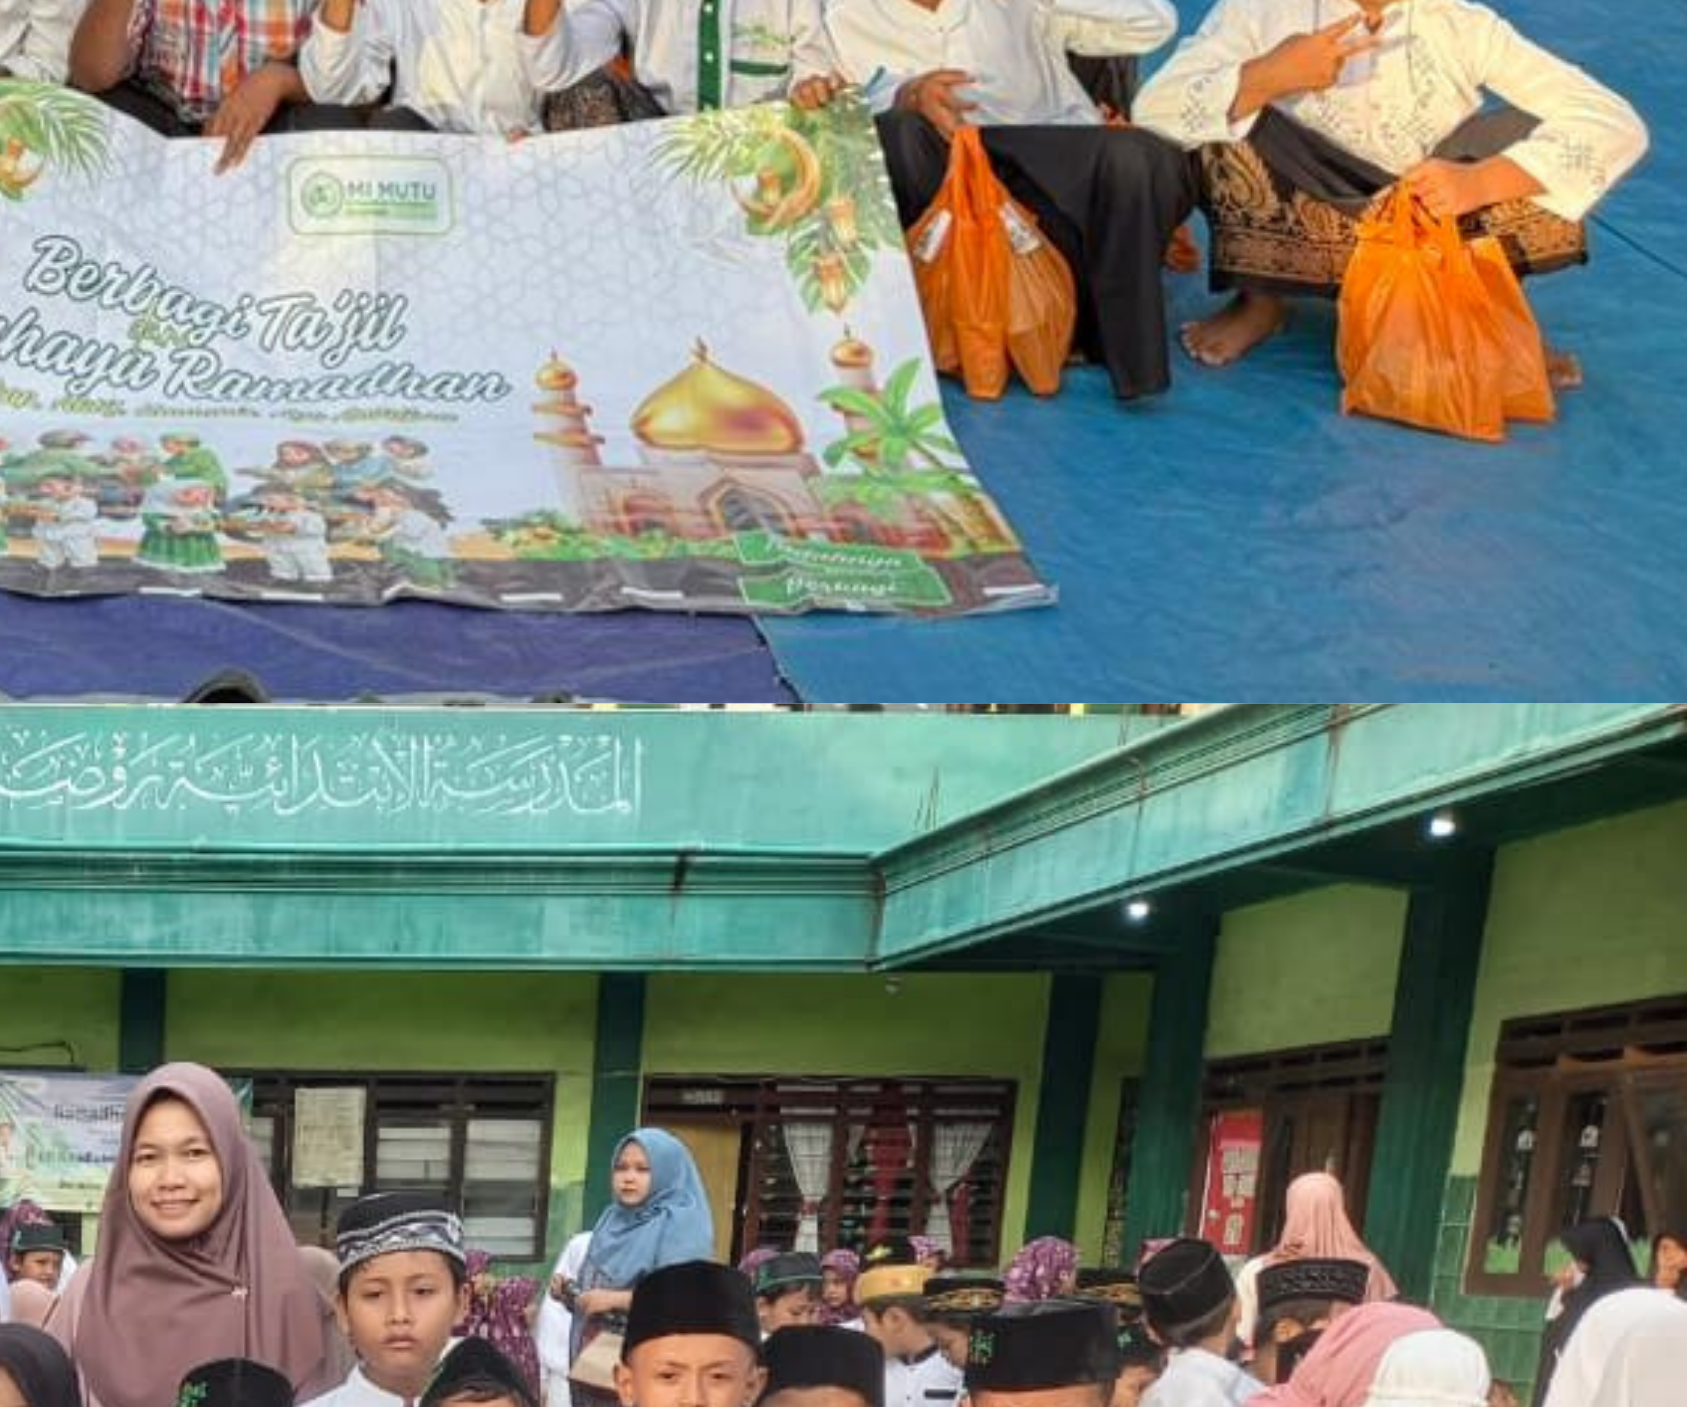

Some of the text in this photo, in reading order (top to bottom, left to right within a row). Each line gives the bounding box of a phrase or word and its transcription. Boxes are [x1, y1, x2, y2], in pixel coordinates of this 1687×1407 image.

[348, 181, 436, 200] MI MUTU
[23, 234, 410, 370] Berbagi Ta'jil
[164, 346, 515, 402] Ramadhan
